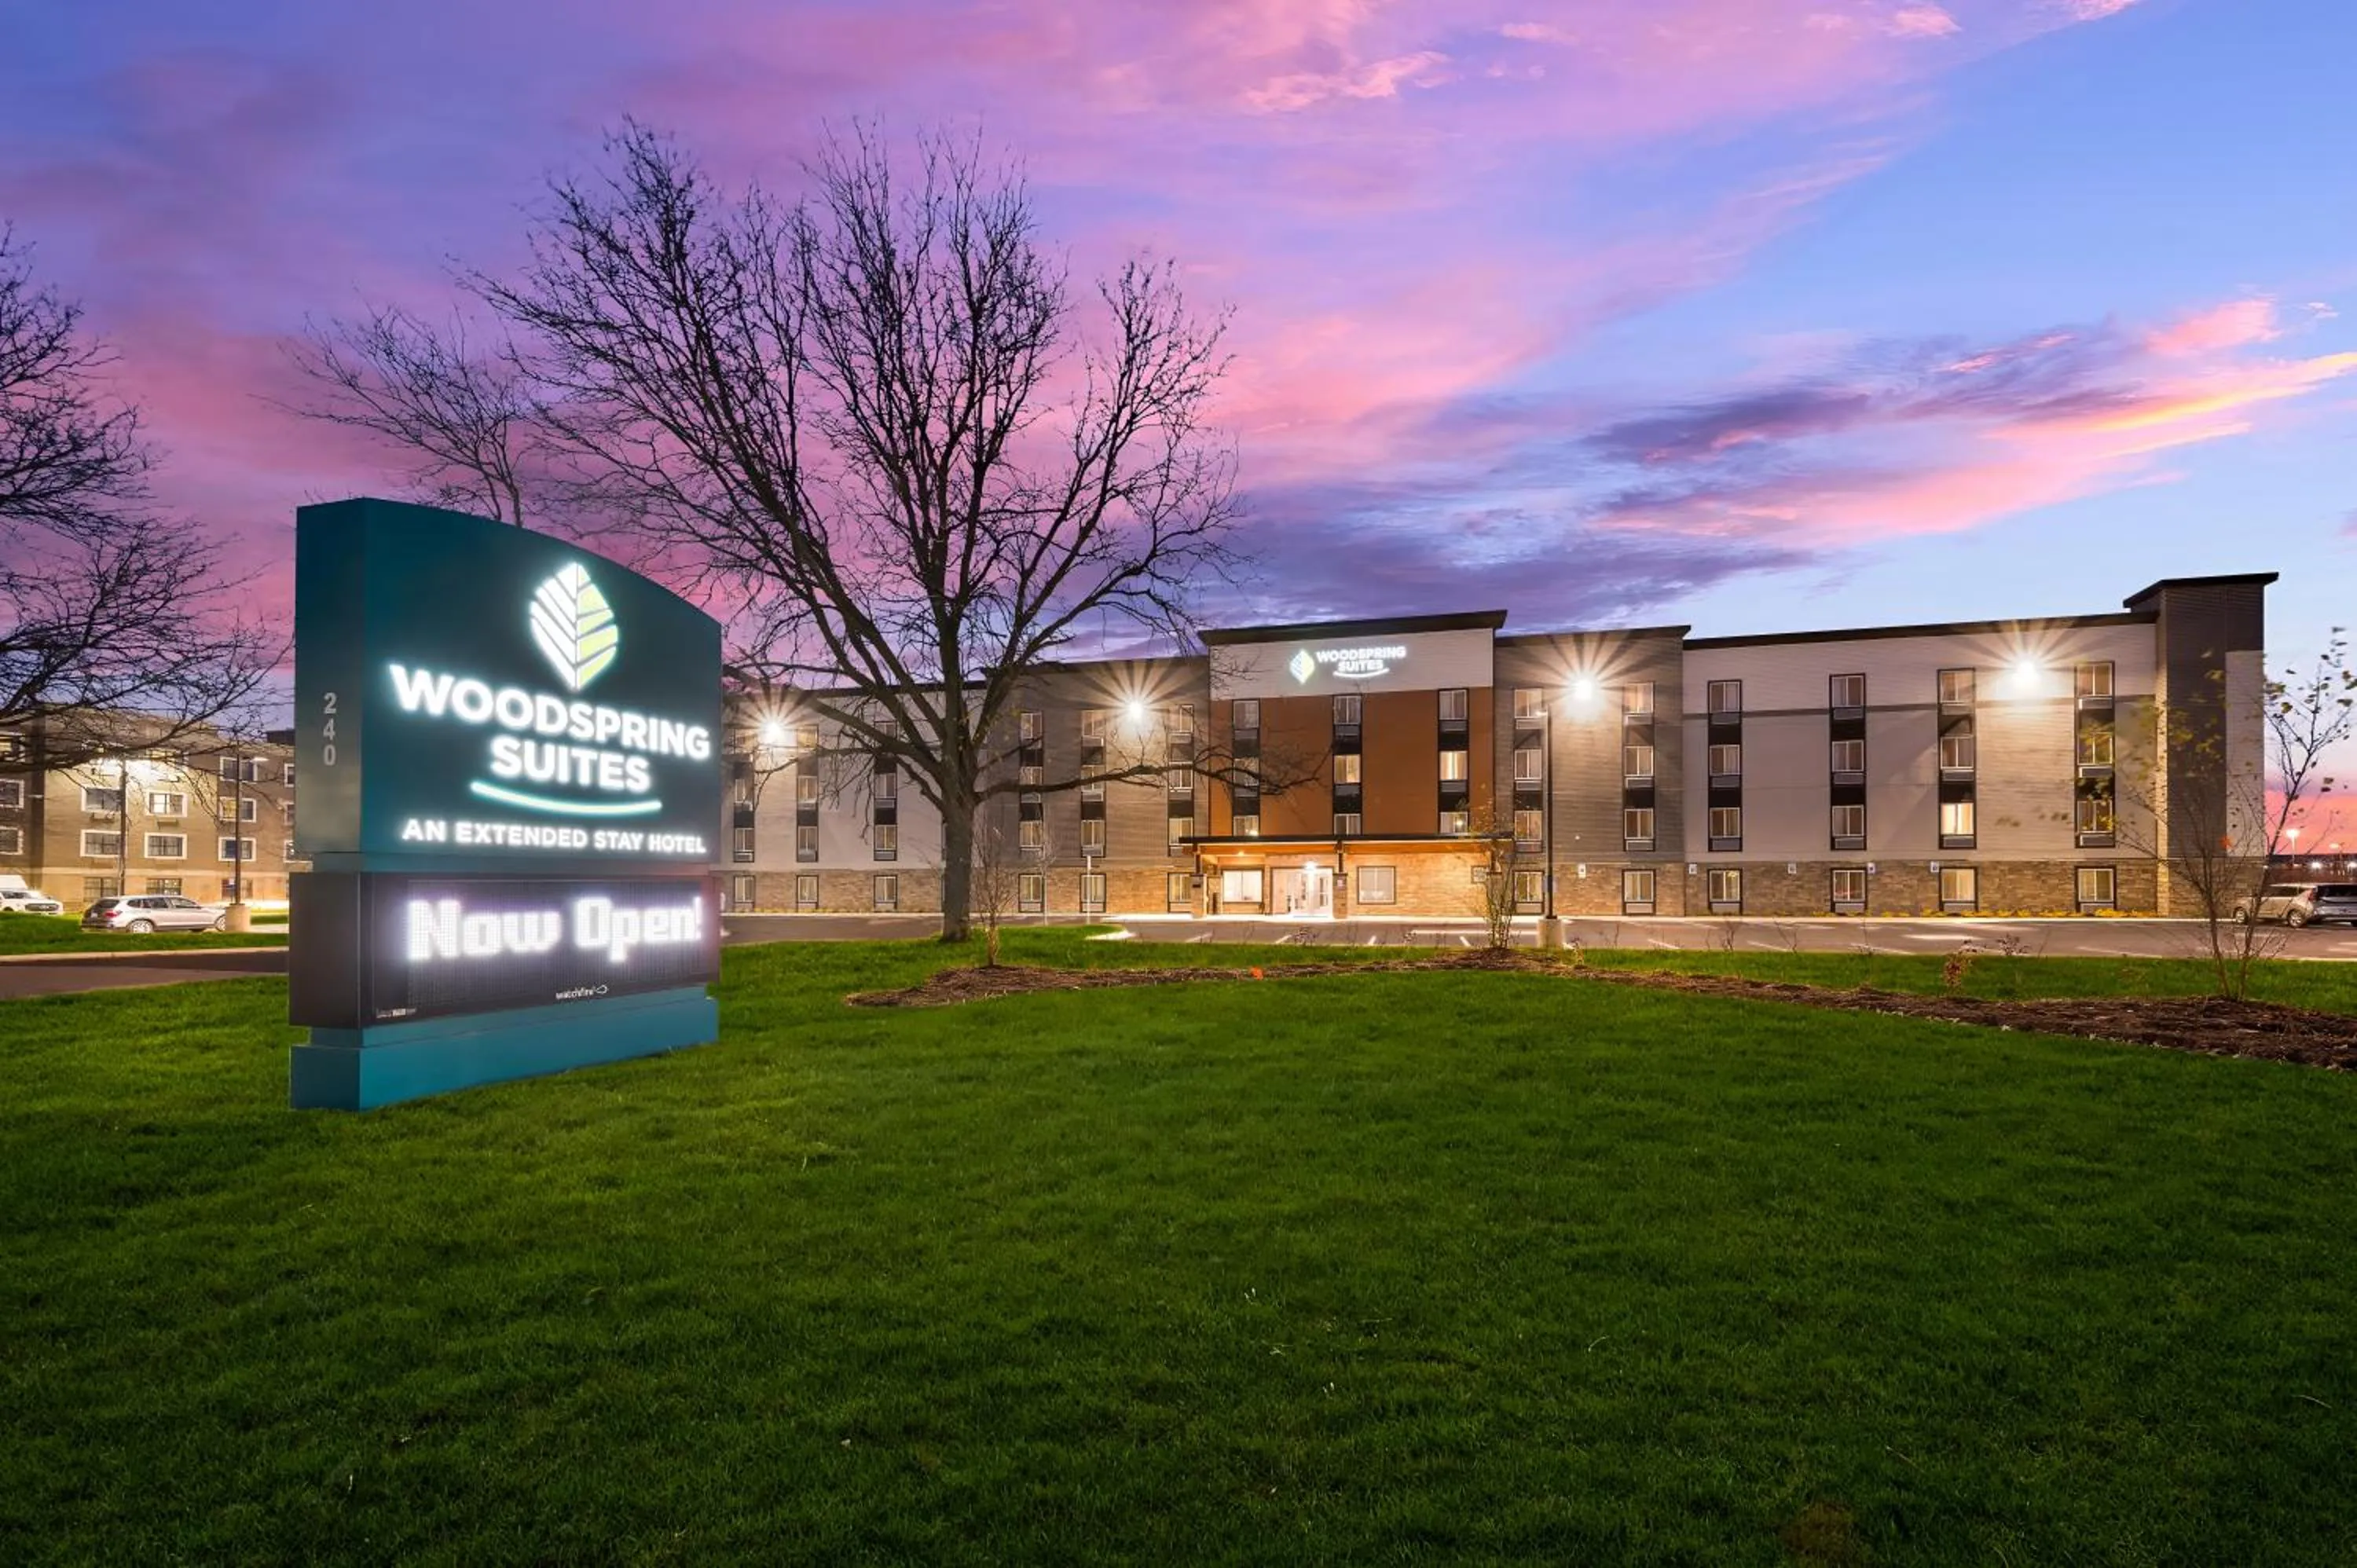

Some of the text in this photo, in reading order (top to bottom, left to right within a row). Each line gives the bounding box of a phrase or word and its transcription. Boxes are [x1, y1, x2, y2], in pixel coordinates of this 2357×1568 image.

[1316, 646, 1406, 663] WOODSPRING
[1338, 659, 1384, 672] SUITES
[323, 692, 337, 767] 240
[389, 664, 712, 760] WOODSPRING
[489, 735, 654, 793] SUITES
[401, 819, 706, 854] AN EXTENDED STAY HOTEL
[408, 896, 702, 963] Now Open!
